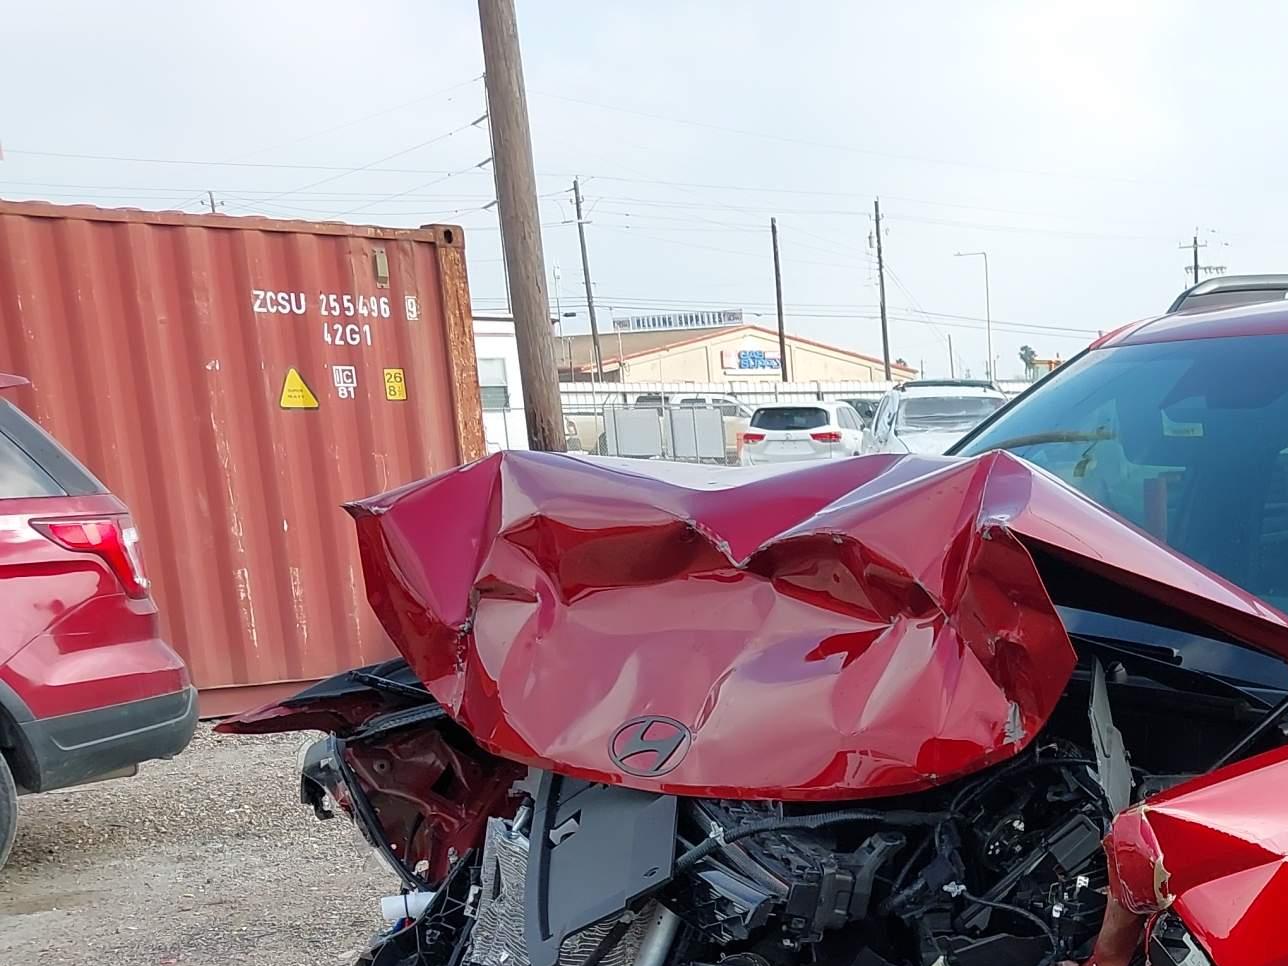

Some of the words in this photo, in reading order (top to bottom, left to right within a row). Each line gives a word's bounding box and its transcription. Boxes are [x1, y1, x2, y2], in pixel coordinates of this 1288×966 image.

[253, 290, 306, 314] ZCSU
[319, 294, 391, 318] 255496
[323, 322, 372, 346] 42G1
[338, 386, 355, 400] 81
